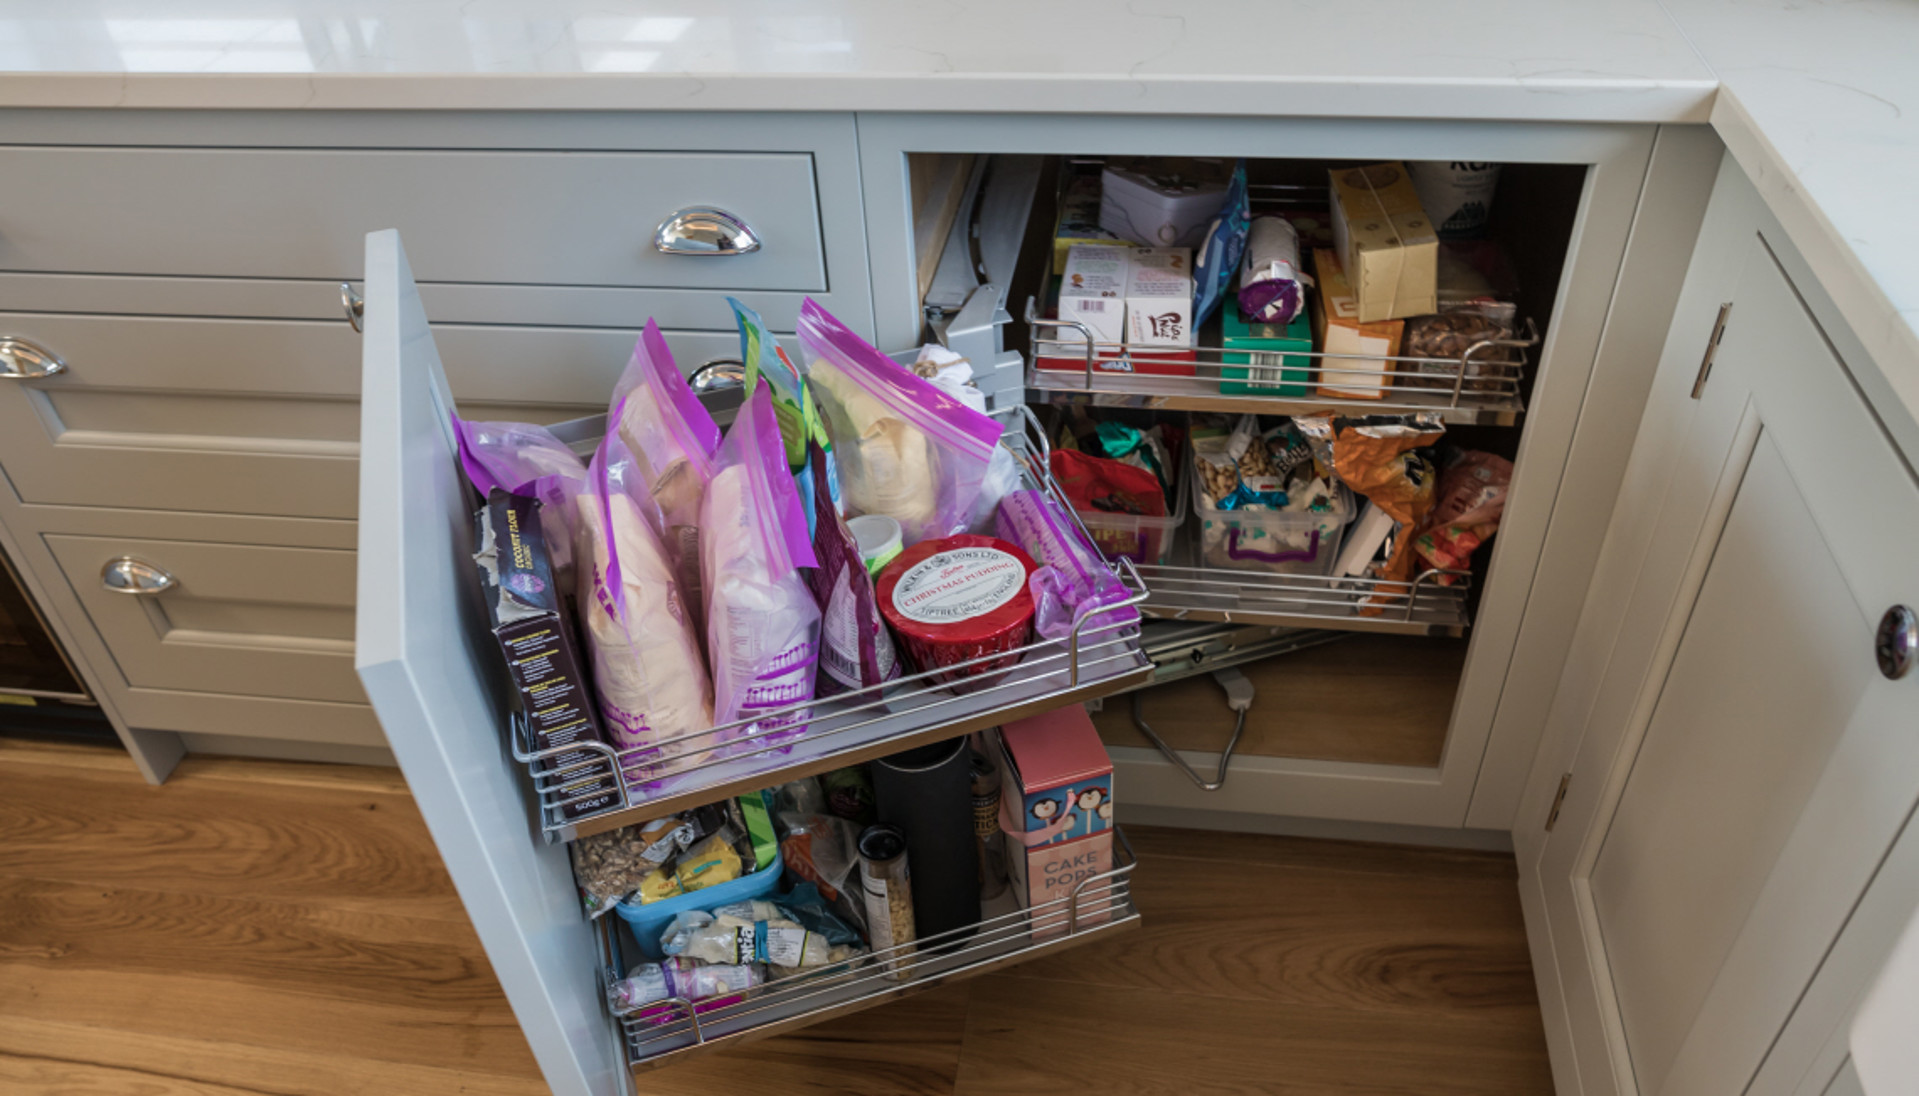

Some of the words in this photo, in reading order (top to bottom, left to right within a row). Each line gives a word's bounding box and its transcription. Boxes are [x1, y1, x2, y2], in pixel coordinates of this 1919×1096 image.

[951, 550, 979, 561] SONS
[980, 550, 999, 560] LTD
[903, 577, 964, 608] CHRISTMAS
[964, 560, 1015, 582] PUDDING
[1044, 850, 1098, 874] CAKE
[1045, 865, 1098, 890] POPS
